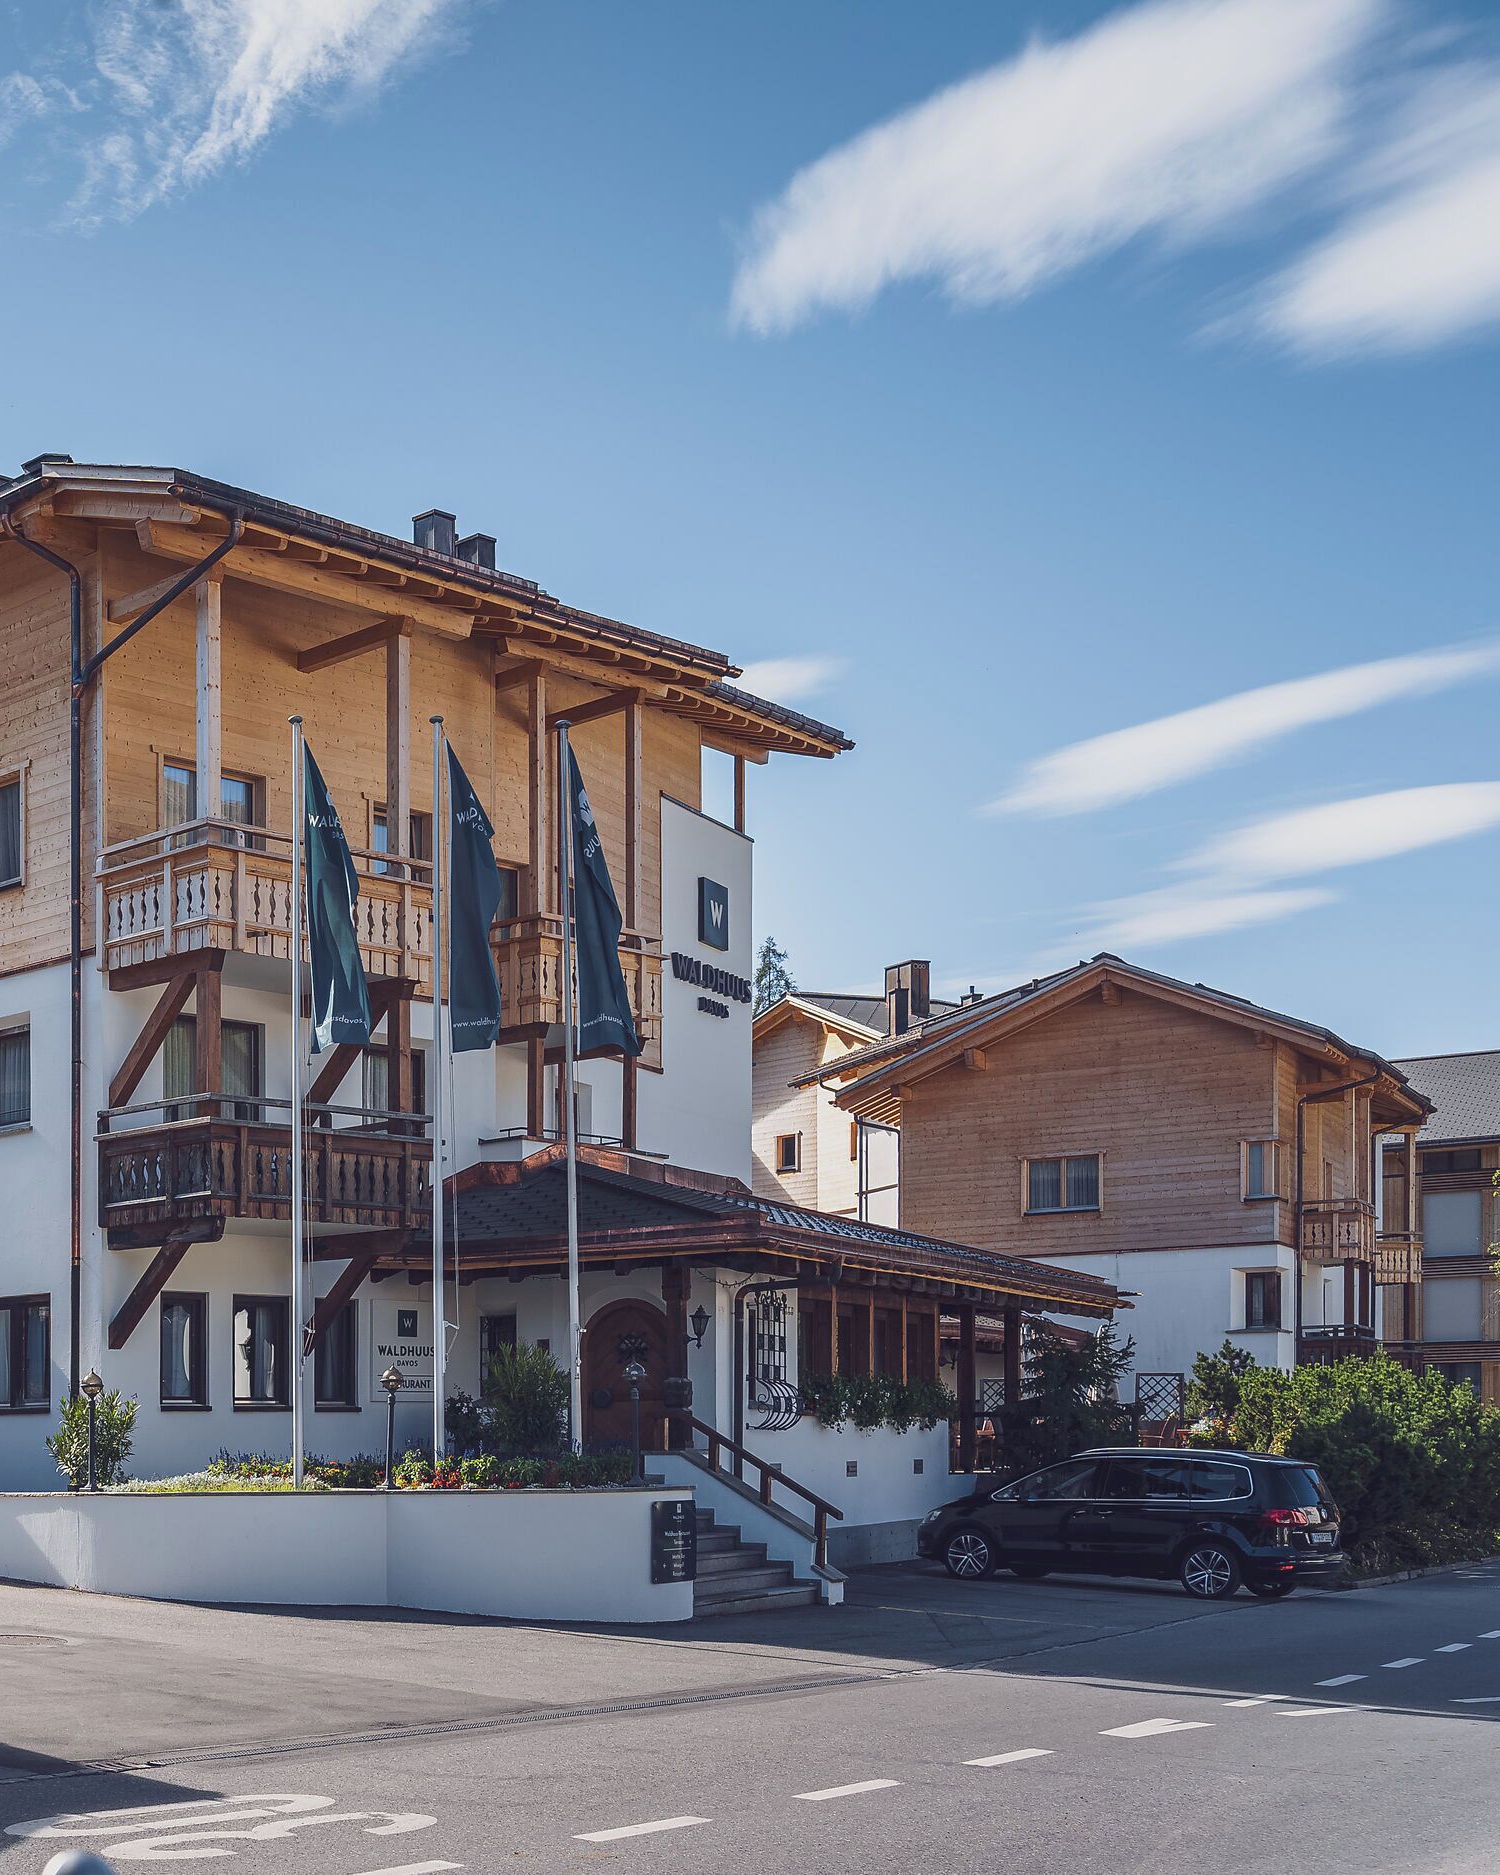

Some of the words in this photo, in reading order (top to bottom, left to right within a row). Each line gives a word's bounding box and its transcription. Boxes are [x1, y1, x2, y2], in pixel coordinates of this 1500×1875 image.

[709, 899, 724, 929] W
[670, 951, 753, 1004] WALDHUUS
[697, 996, 730, 1019] DAVOS
[403, 1317, 413, 1329] W
[377, 1344, 435, 1357] WALDHUUS
[396, 1359, 419, 1367] DAVOS
